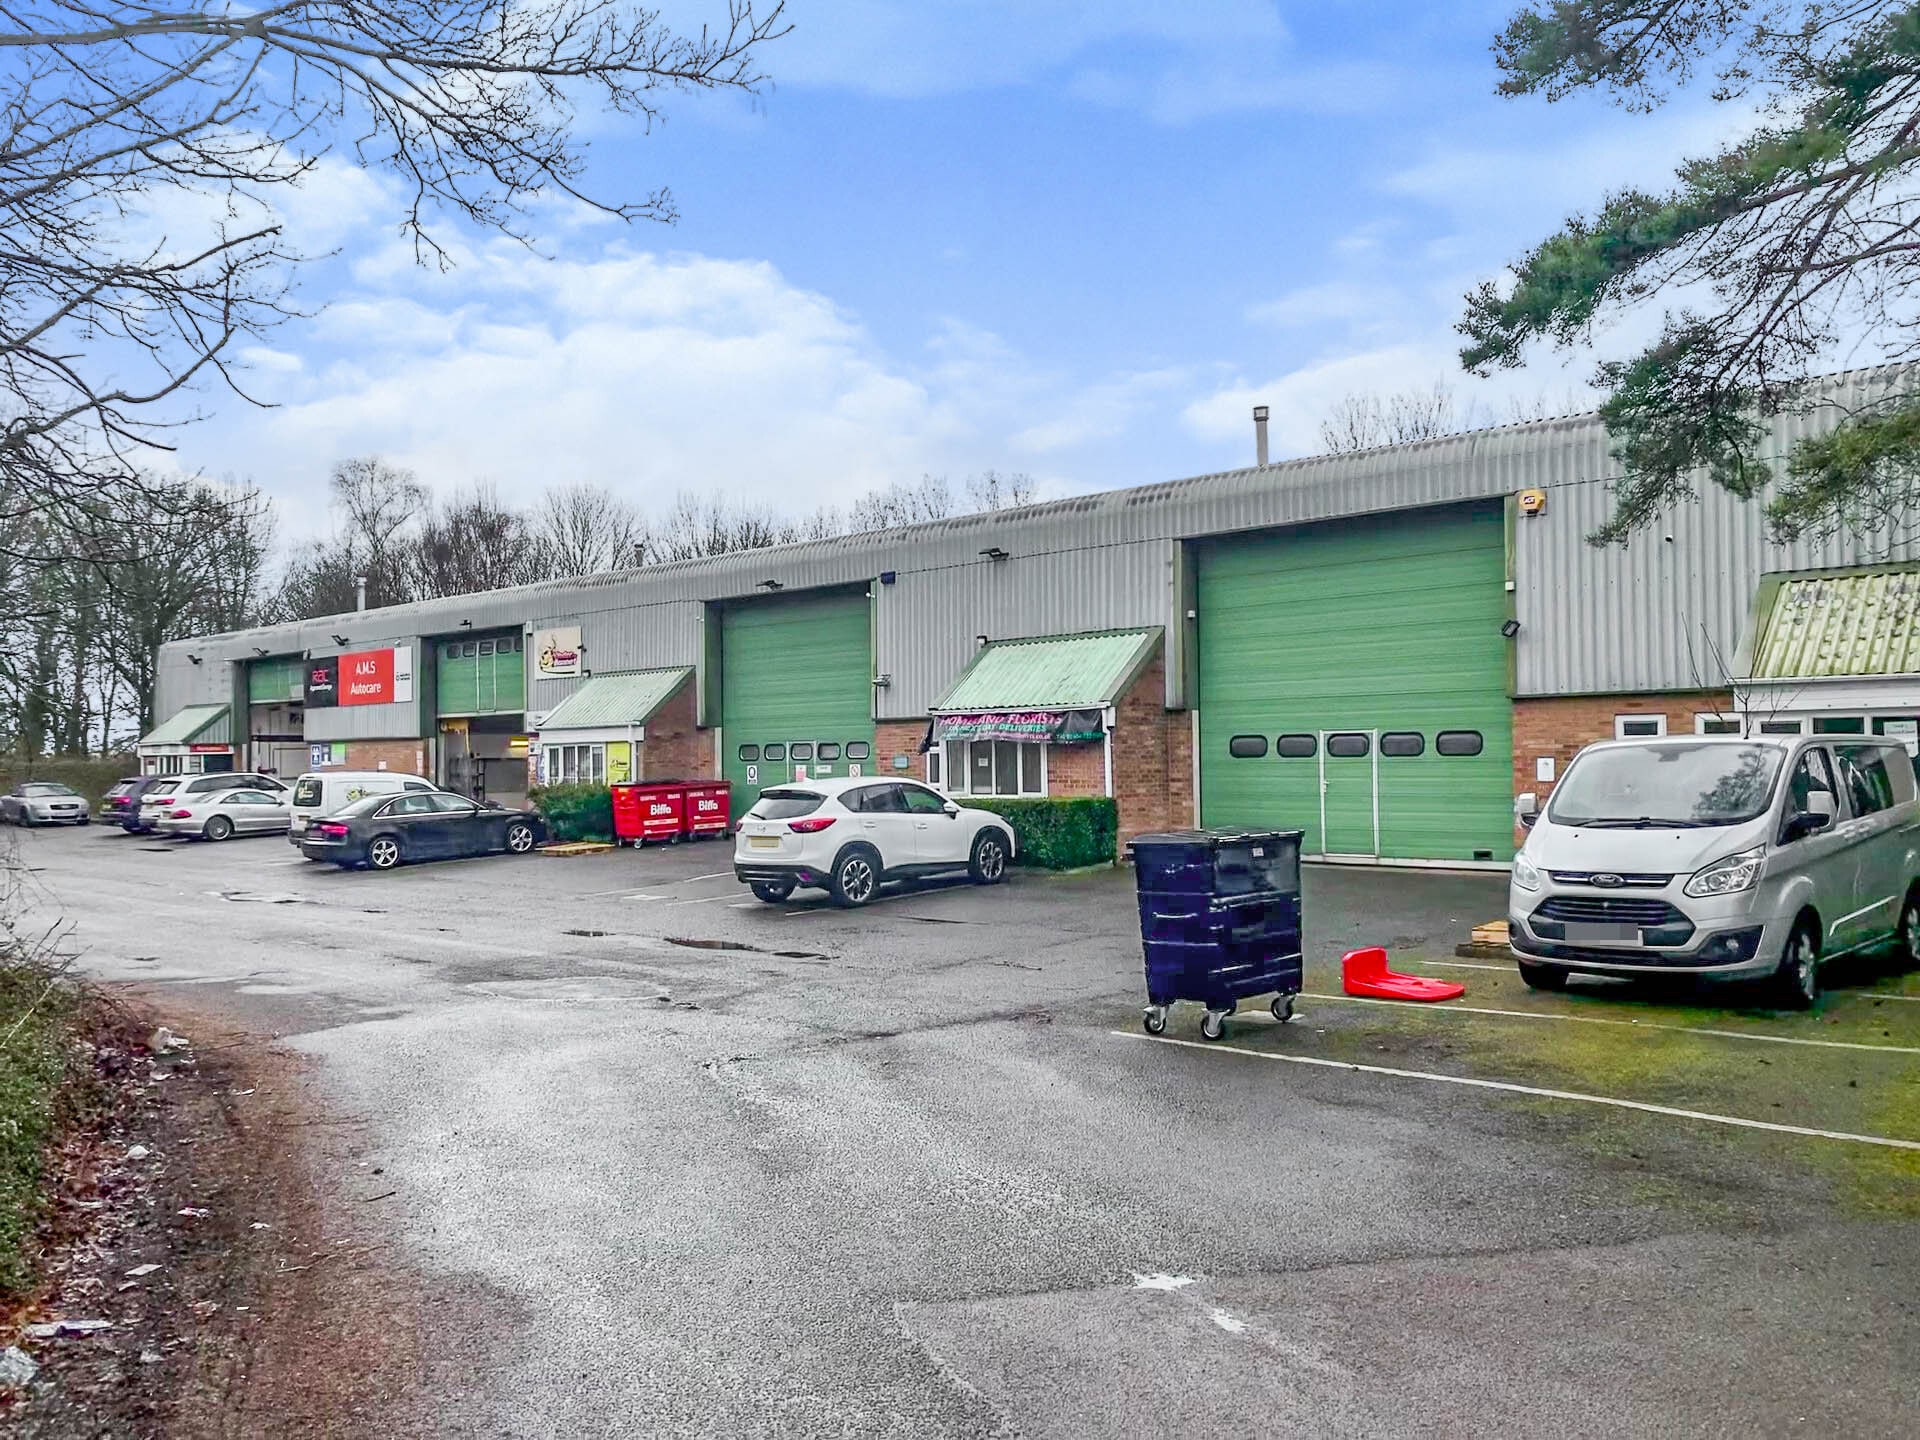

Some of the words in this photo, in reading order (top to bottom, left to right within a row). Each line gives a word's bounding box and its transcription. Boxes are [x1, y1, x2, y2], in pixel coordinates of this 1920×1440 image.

[355, 660, 376, 675] A.M.S
[350, 682, 382, 695] Autocare
[998, 723, 1047, 733] DELIVERIES
[650, 803, 672, 815] Biffa
[698, 800, 718, 811] Biffa
